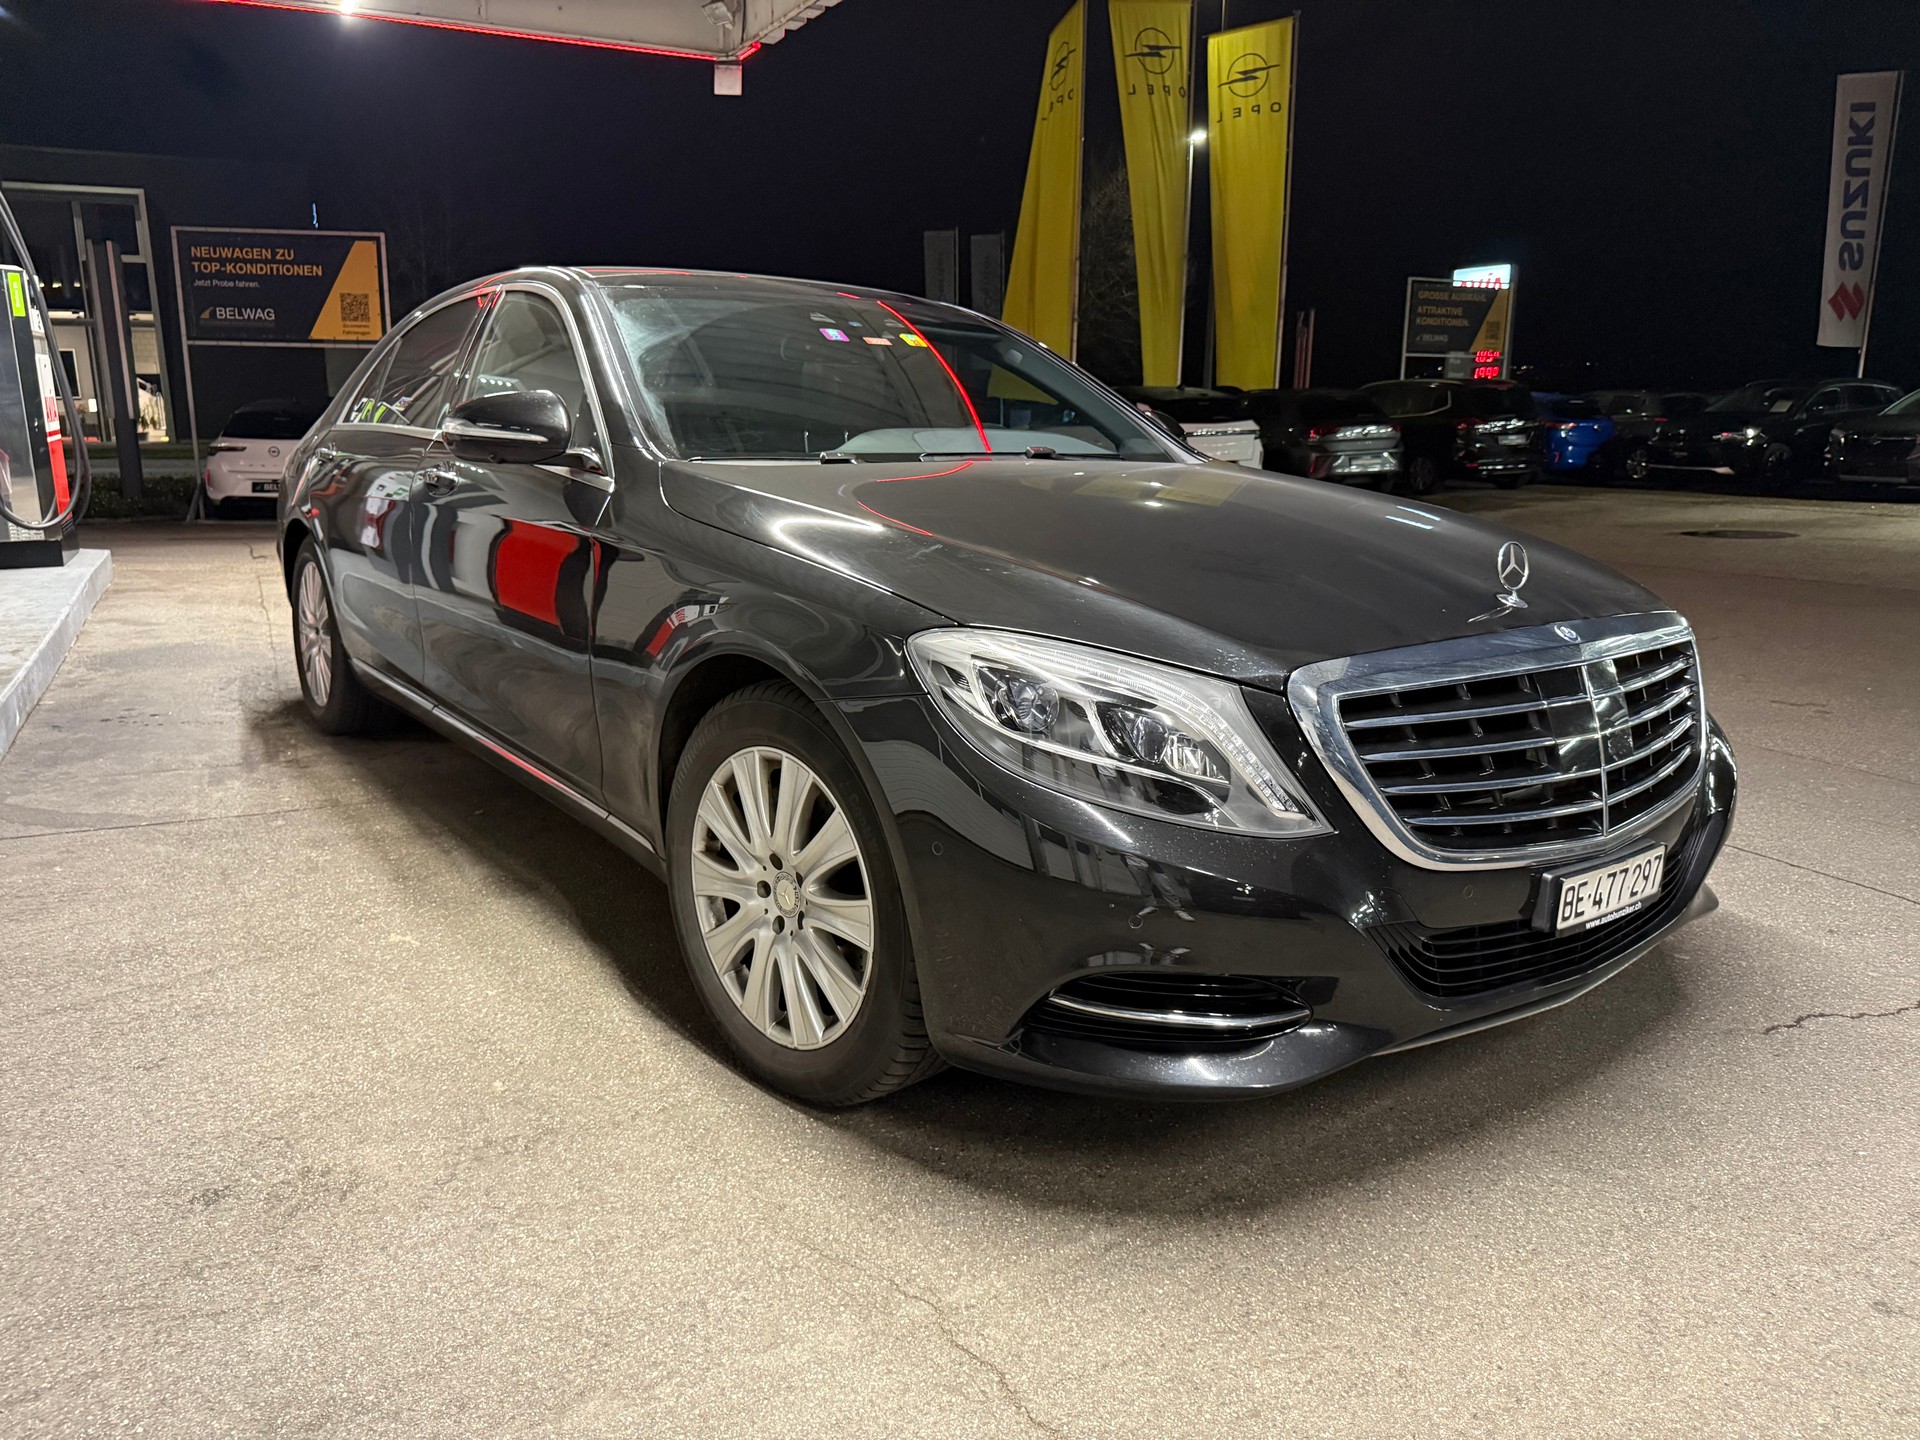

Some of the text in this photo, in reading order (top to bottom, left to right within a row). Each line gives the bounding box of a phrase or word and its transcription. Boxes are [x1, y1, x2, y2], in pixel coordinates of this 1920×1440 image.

[190, 245, 295, 261] NEUWAGEN ZU
[191, 261, 323, 277] TOP-KONDITIONEN
[193, 279, 261, 288] Jetzt Probe fahren.
[1418, 291, 1449, 300] GROSSE
[216, 307, 275, 321] BELWAG
[1417, 306, 1463, 315] ATTRAKTIVE
[1629, 853, 1663, 898] 297
[1585, 902, 1642, 929] www.autohunziker.ch
